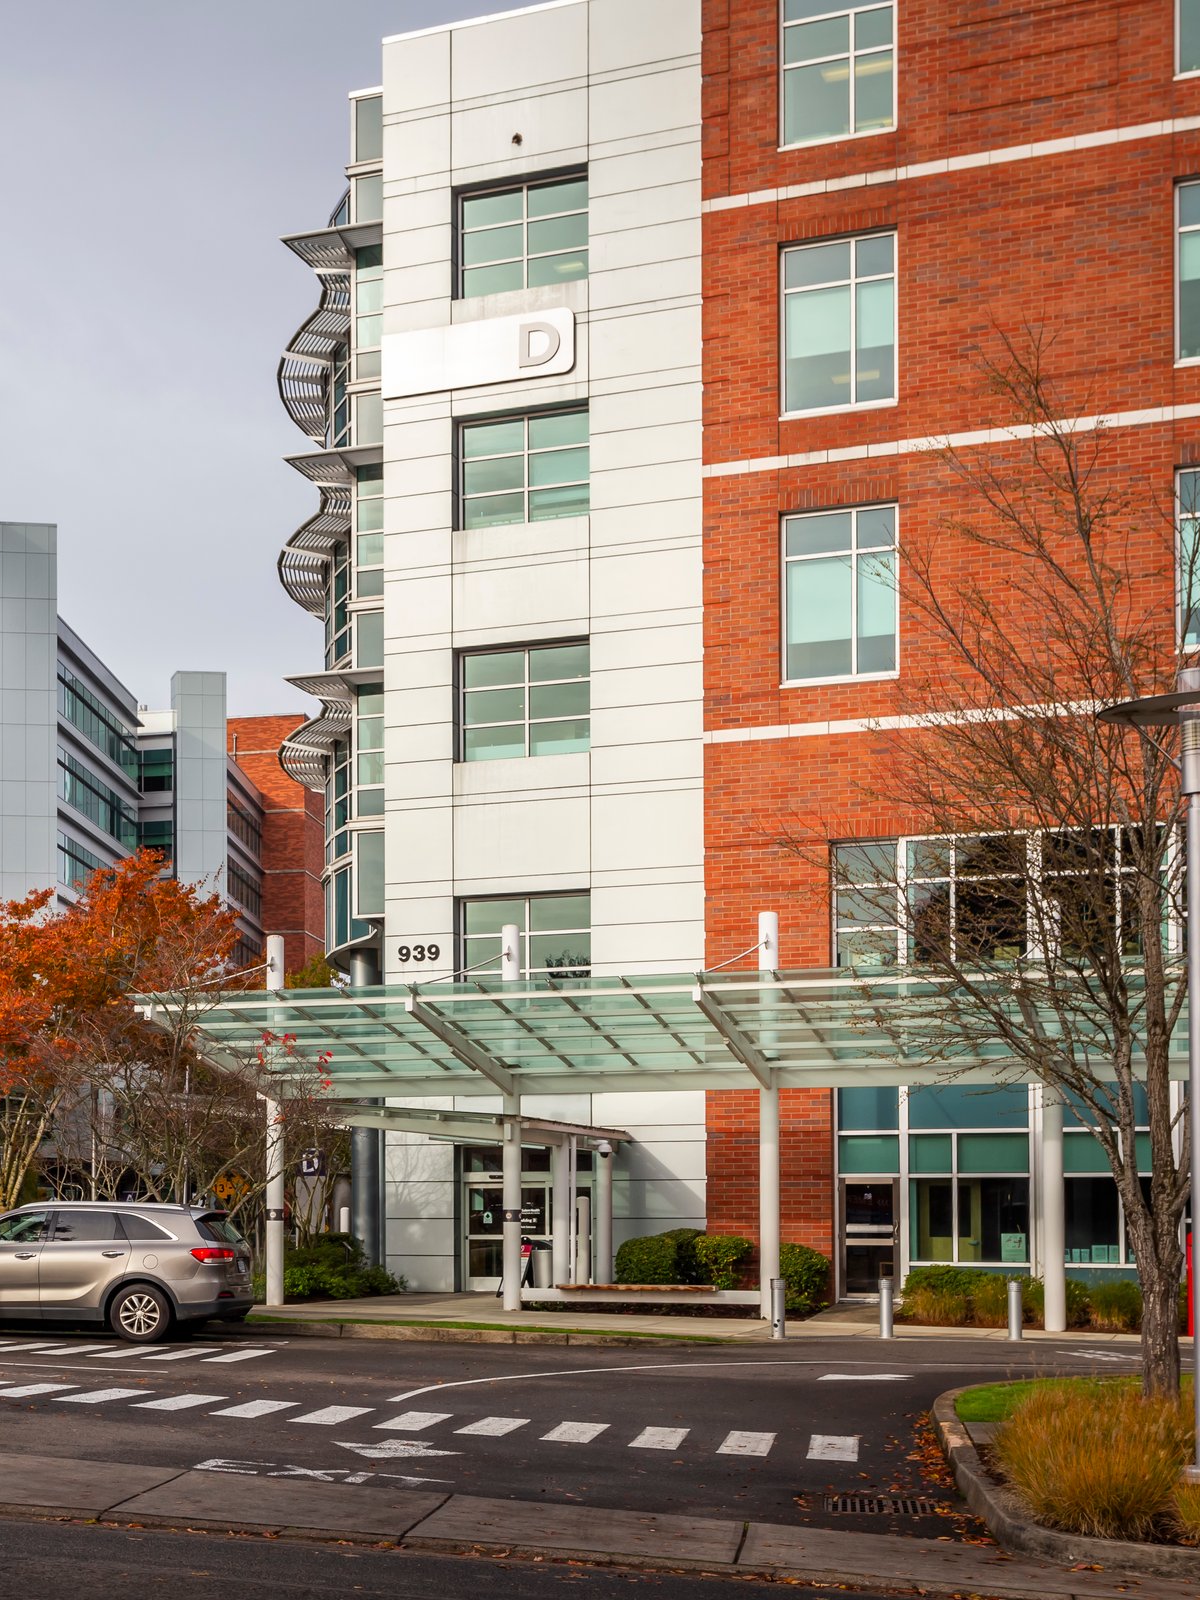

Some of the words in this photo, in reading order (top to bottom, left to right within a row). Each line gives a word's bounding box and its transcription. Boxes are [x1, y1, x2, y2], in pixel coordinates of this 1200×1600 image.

[519, 320, 561, 369] D
[398, 944, 440, 963] 939
[193, 1458, 455, 1484] EXIT
